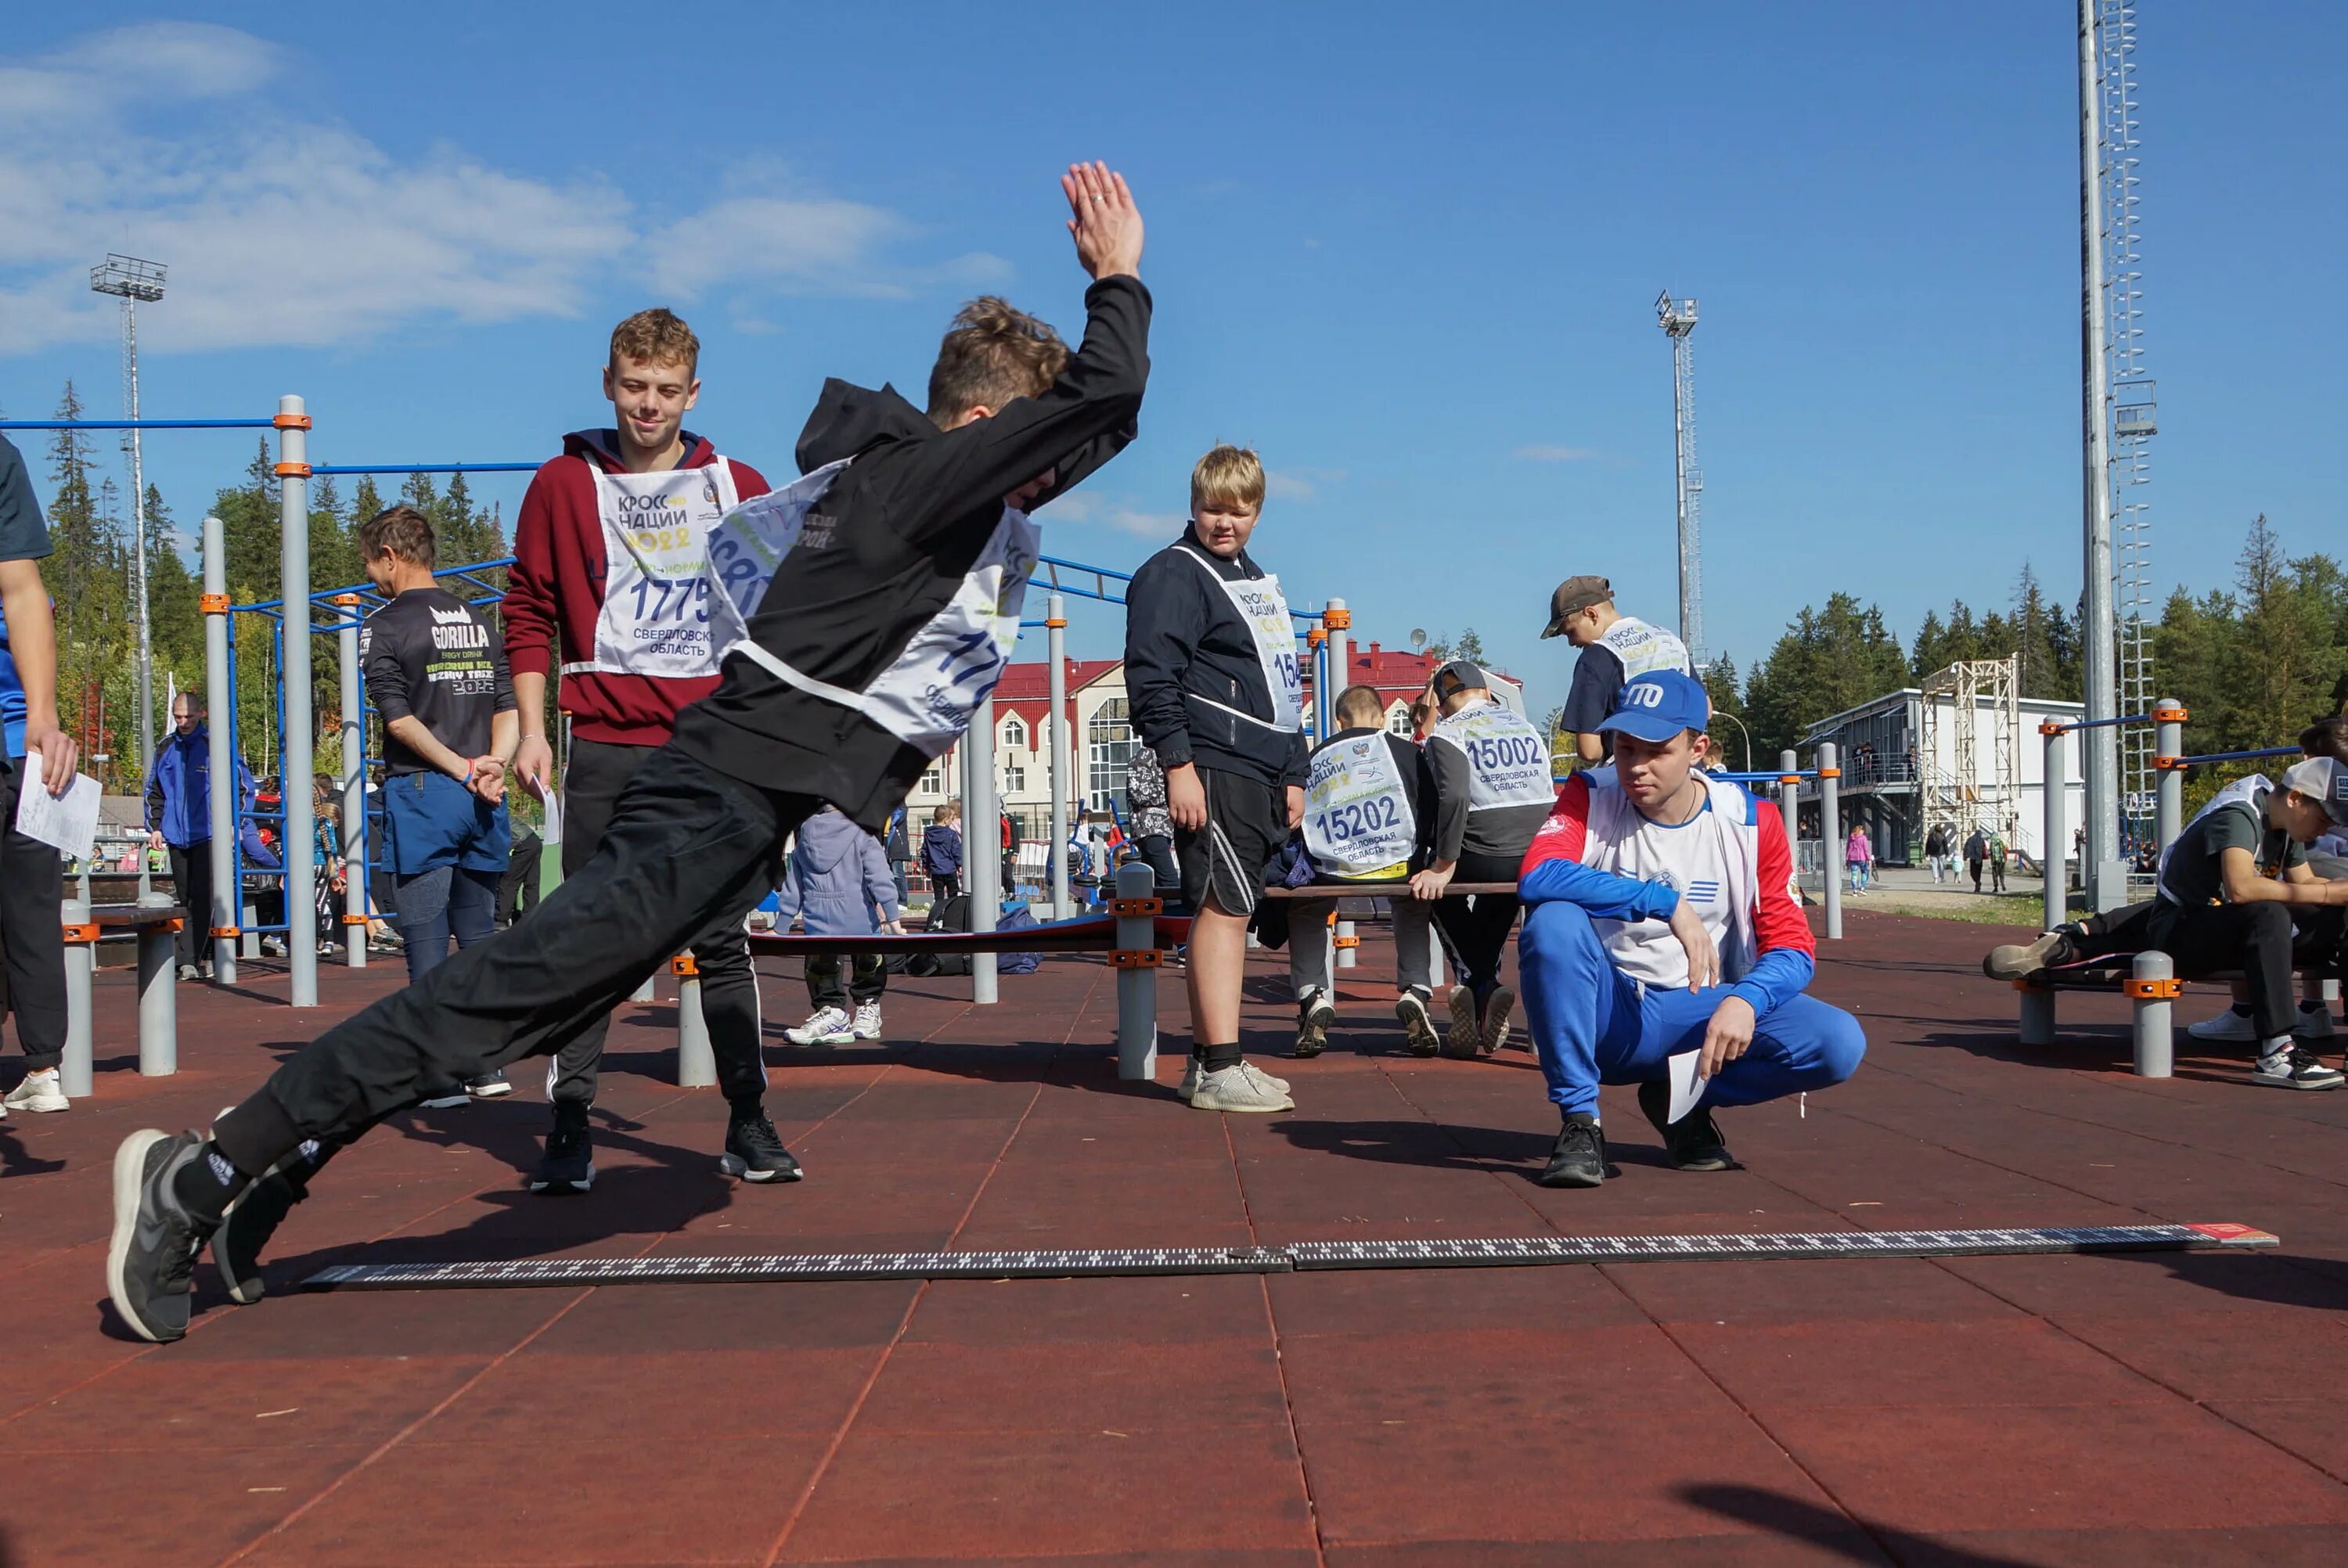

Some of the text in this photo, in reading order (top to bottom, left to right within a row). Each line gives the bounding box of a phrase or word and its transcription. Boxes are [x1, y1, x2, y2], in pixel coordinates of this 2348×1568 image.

[618, 494, 668, 512] КРОСС
[619, 510, 687, 530] НАЦИИ
[630, 577, 711, 623] 1775
[1240, 593, 1263, 605] КРОС
[1246, 603, 1277, 617] НАЦИИ
[431, 624, 489, 649] GORILLA
[634, 628, 712, 642] СВЕРДЛОВСК
[1608, 627, 1637, 642] КРОСС
[1615, 632, 1652, 649] НАЦИИ
[650, 643, 705, 656] ОБЛАСТЬ
[1274, 652, 1301, 688] 154
[452, 679, 495, 696] 2022
[1467, 737, 1542, 770] 15002
[1310, 757, 1332, 774] ОСС
[1308, 762, 1346, 792] НАЦИИ
[1480, 769, 1540, 783] СВЕРДЛОВСКАЯ
[1311, 773, 1351, 803] 2022
[1494, 783, 1528, 792] ОБЛАСТЬ
[1316, 795, 1401, 844] 15202
[1333, 832, 1396, 855] СВЕРДЛОВСКАЯ
[1348, 846, 1385, 862] ОБЛАСТЬ
